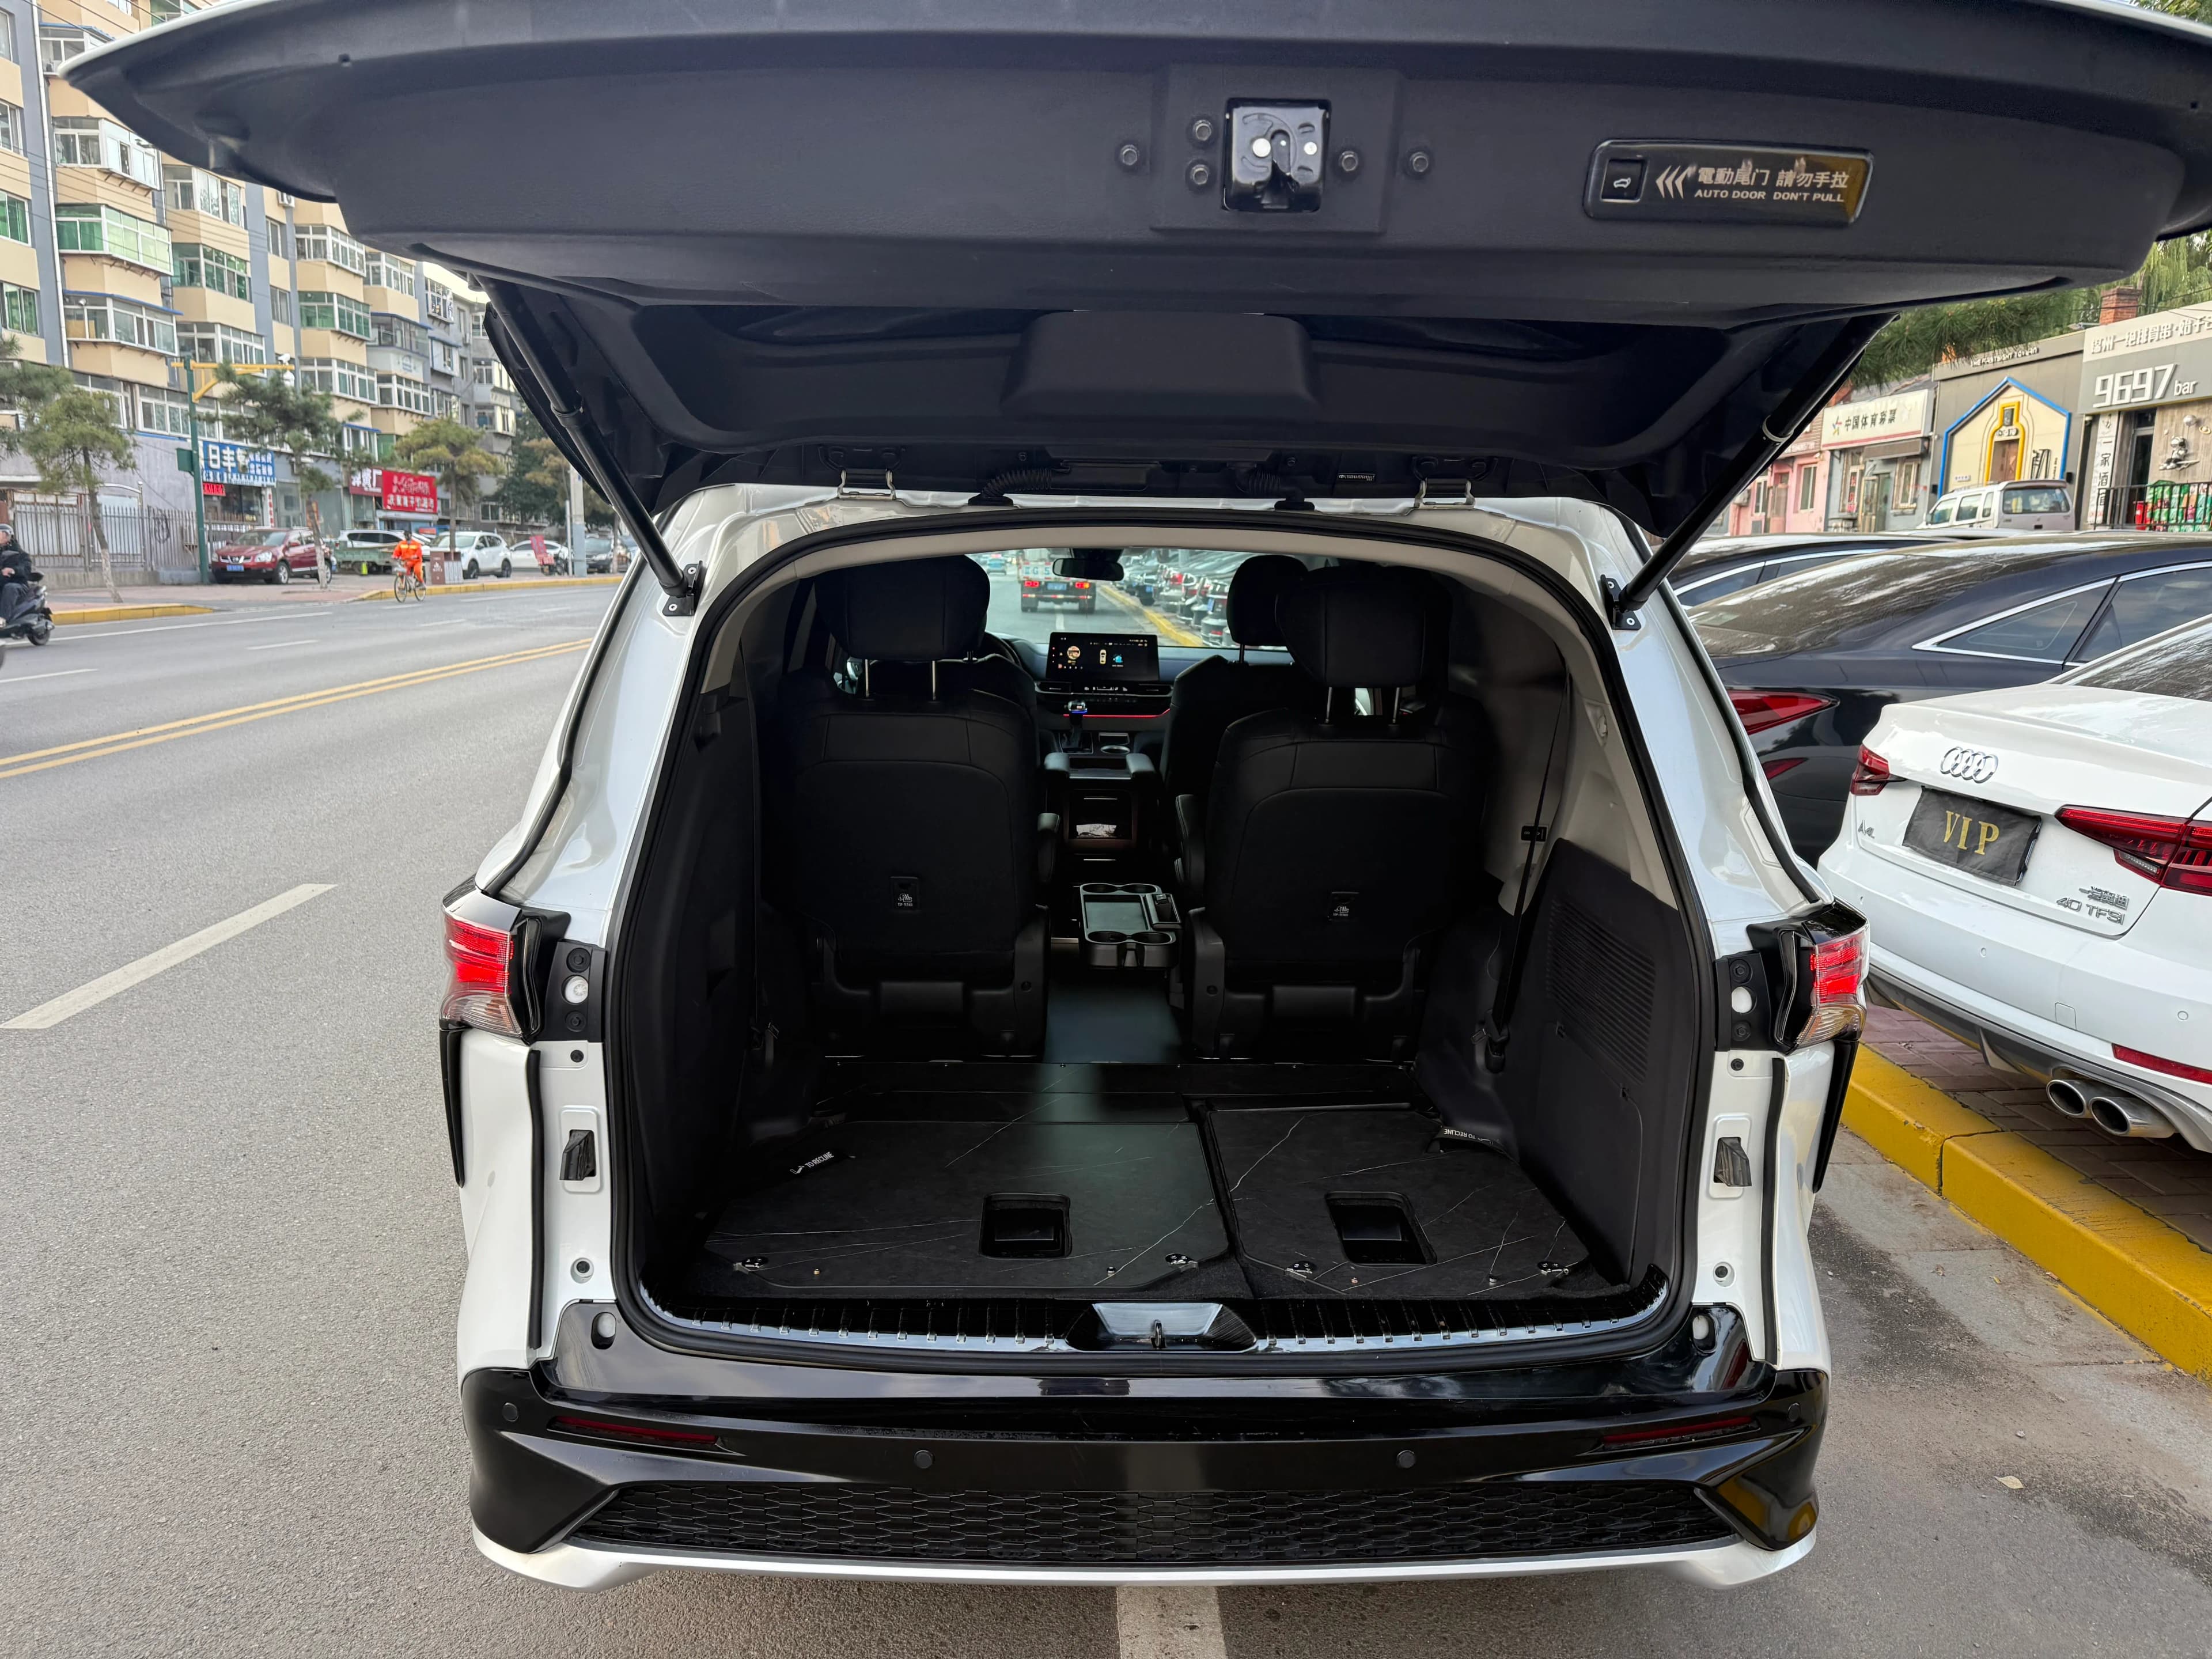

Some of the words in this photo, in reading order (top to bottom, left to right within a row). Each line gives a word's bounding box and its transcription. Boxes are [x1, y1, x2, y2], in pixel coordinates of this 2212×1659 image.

[1695, 190, 1729, 198] AUTO
[1732, 190, 1766, 199] DOOR
[1773, 191, 1810, 200] DON'T
[1813, 193, 1844, 202] PULL
[2093, 363, 2176, 408] 9697
[2174, 380, 2197, 396] bar
[1844, 408, 1897, 431] 中国体育彩票
[1858, 820, 1875, 839] A4L
[1944, 810, 1999, 855] VIP
[2056, 897, 2082, 912] 40
[2086, 904, 2126, 926] TFSI
[812, 1152, 835, 1165] RECLINE
